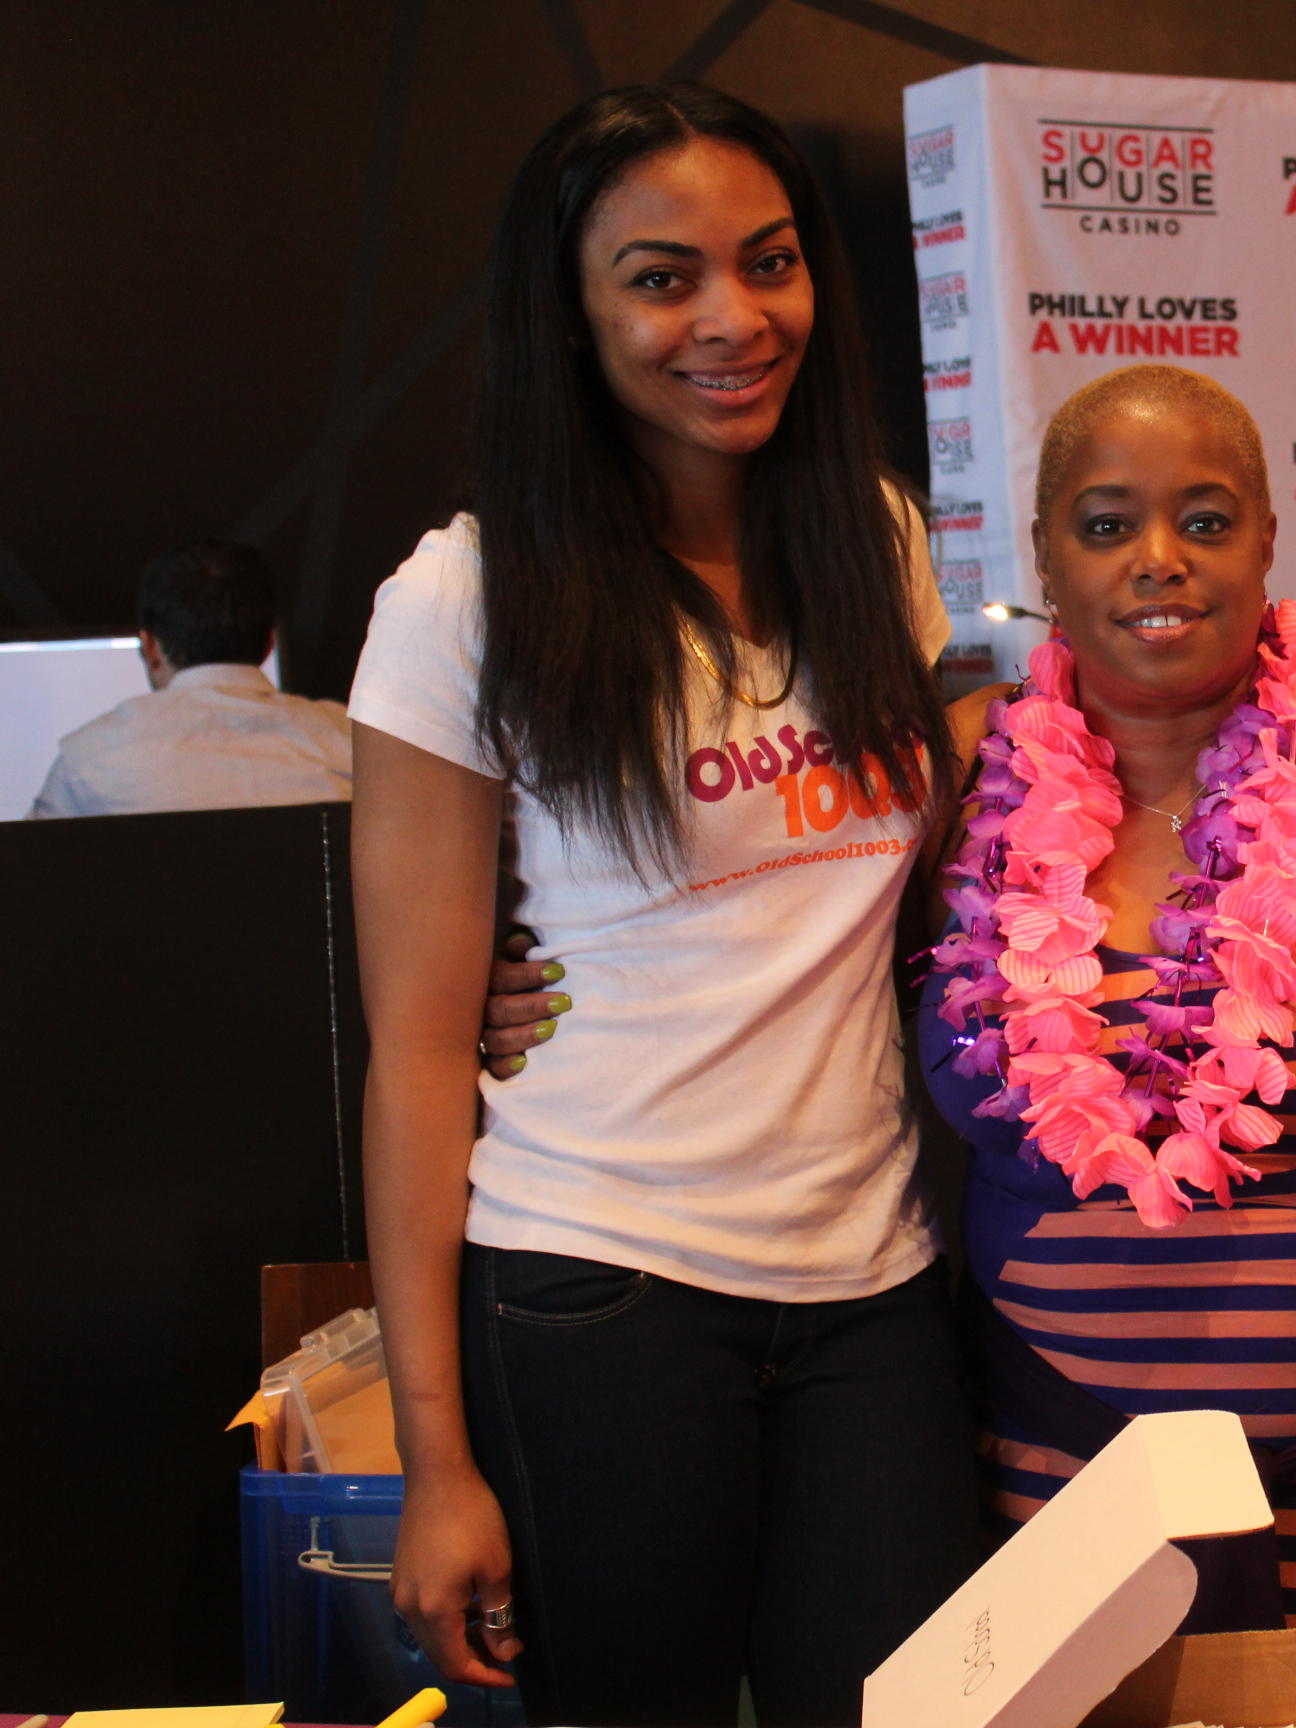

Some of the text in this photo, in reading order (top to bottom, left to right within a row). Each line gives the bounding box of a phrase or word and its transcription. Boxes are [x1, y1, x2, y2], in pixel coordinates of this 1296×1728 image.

[1042, 130, 1214, 170] SUGAR
[1042, 156, 1214, 205] HOUSE
[1080, 215, 1180, 235] CASINO
[1028, 292, 1238, 321] PHILLY LOVES
[1031, 321, 1240, 357] A WINNER
